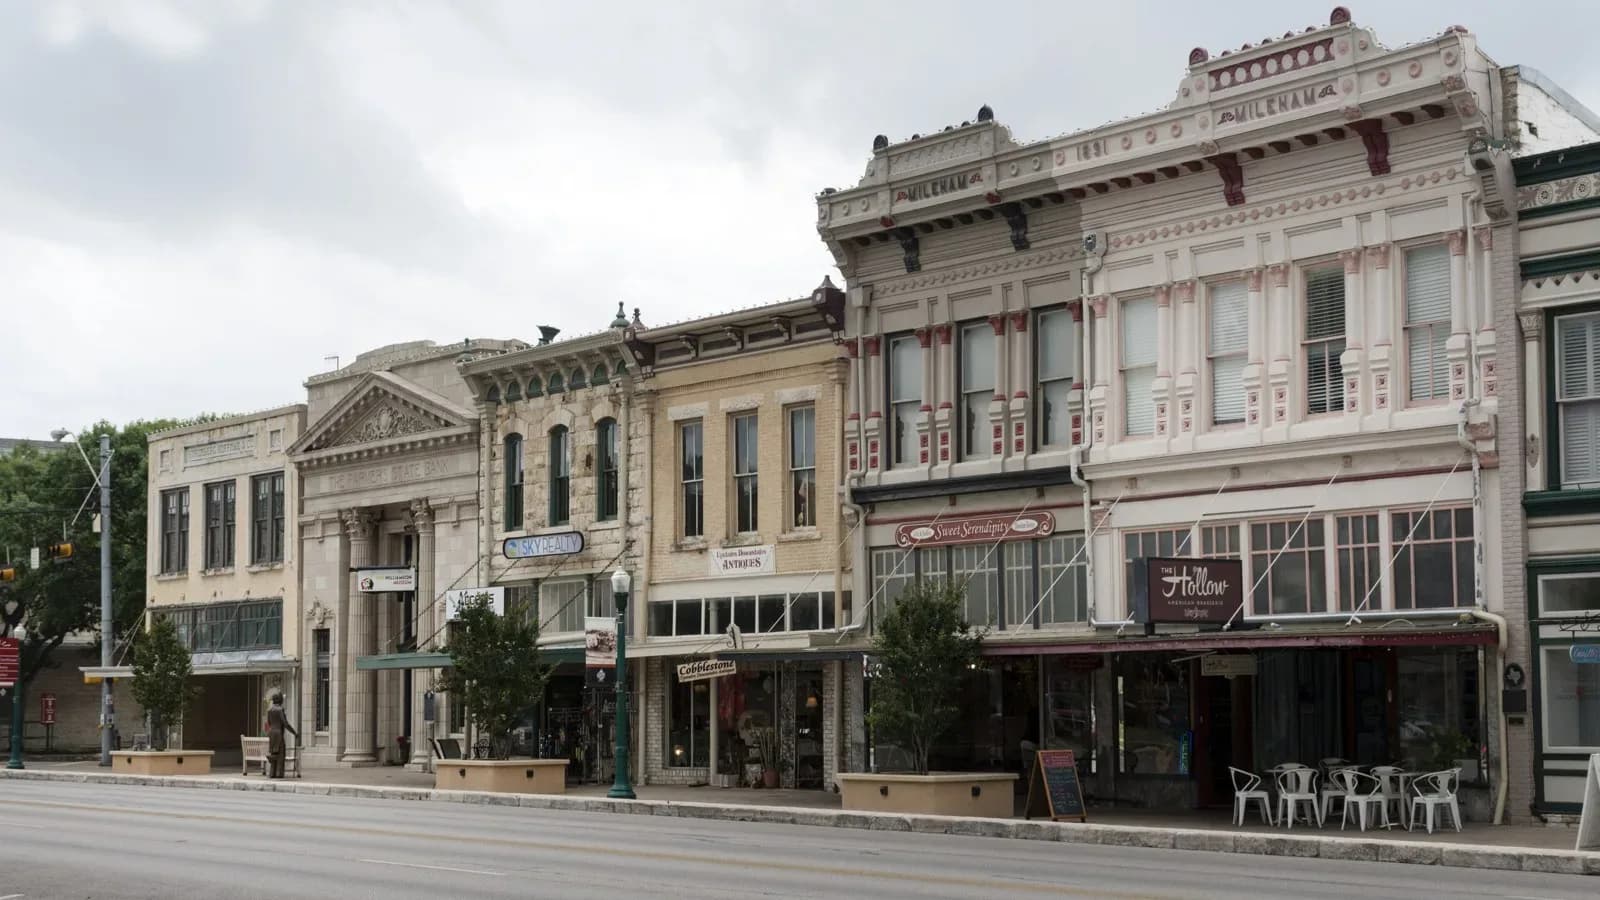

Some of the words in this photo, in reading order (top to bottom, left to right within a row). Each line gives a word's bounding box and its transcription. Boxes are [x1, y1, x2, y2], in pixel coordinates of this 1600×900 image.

[935, 524, 961, 540] Sweet
[961, 519, 1009, 537] Serendipity
[1161, 565, 1230, 598] Hollow
